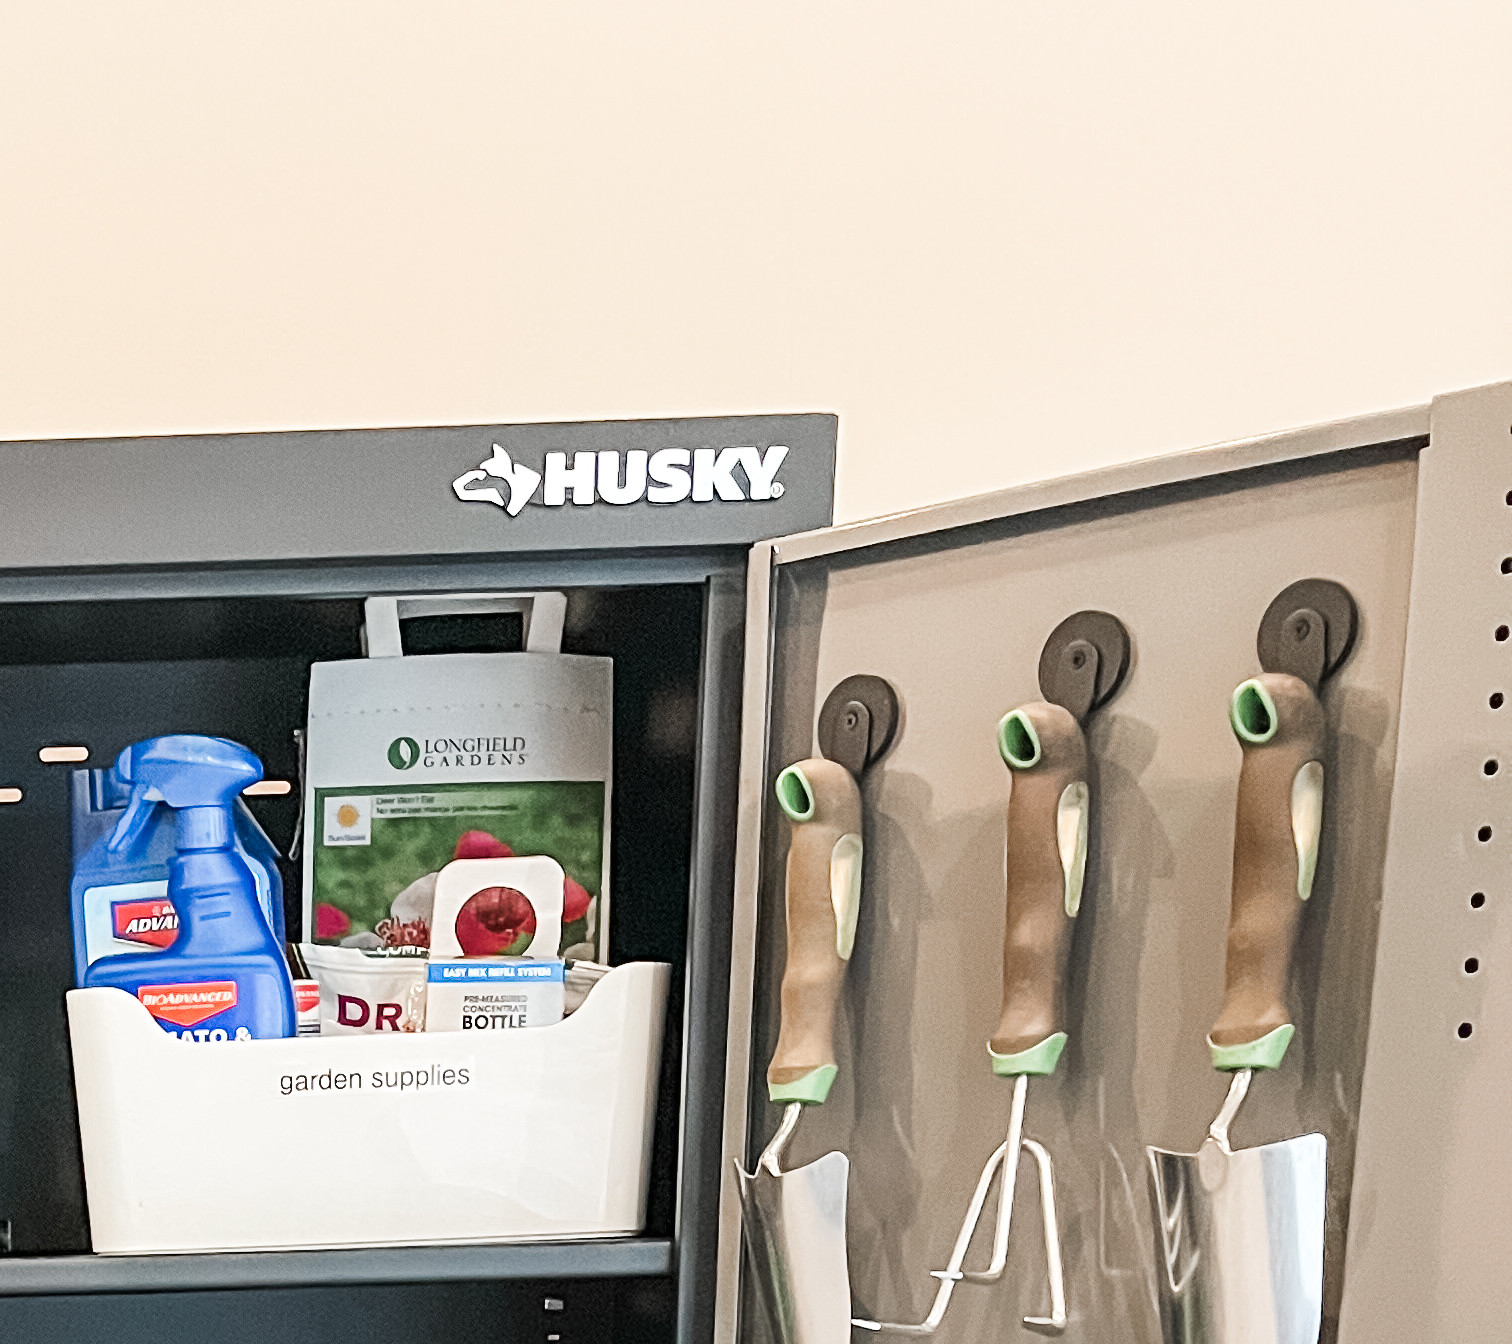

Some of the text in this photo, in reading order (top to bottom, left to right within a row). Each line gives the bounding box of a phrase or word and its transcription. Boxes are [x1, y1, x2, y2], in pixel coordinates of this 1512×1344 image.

[543, 445, 790, 506] HUSKY
[425, 736, 526, 754] LONGFIELD
[423, 753, 526, 767] GARDENS
[444, 967, 467, 977] EASY
[489, 967, 516, 977] REFILL
[517, 967, 551, 977] SYSTEM
[143, 991, 233, 1006] BIOADVANCED
[463, 1005, 528, 1013] CONCENTRATE
[462, 1015, 527, 1030] BOTTLE
[280, 1064, 471, 1096] garden supplies
